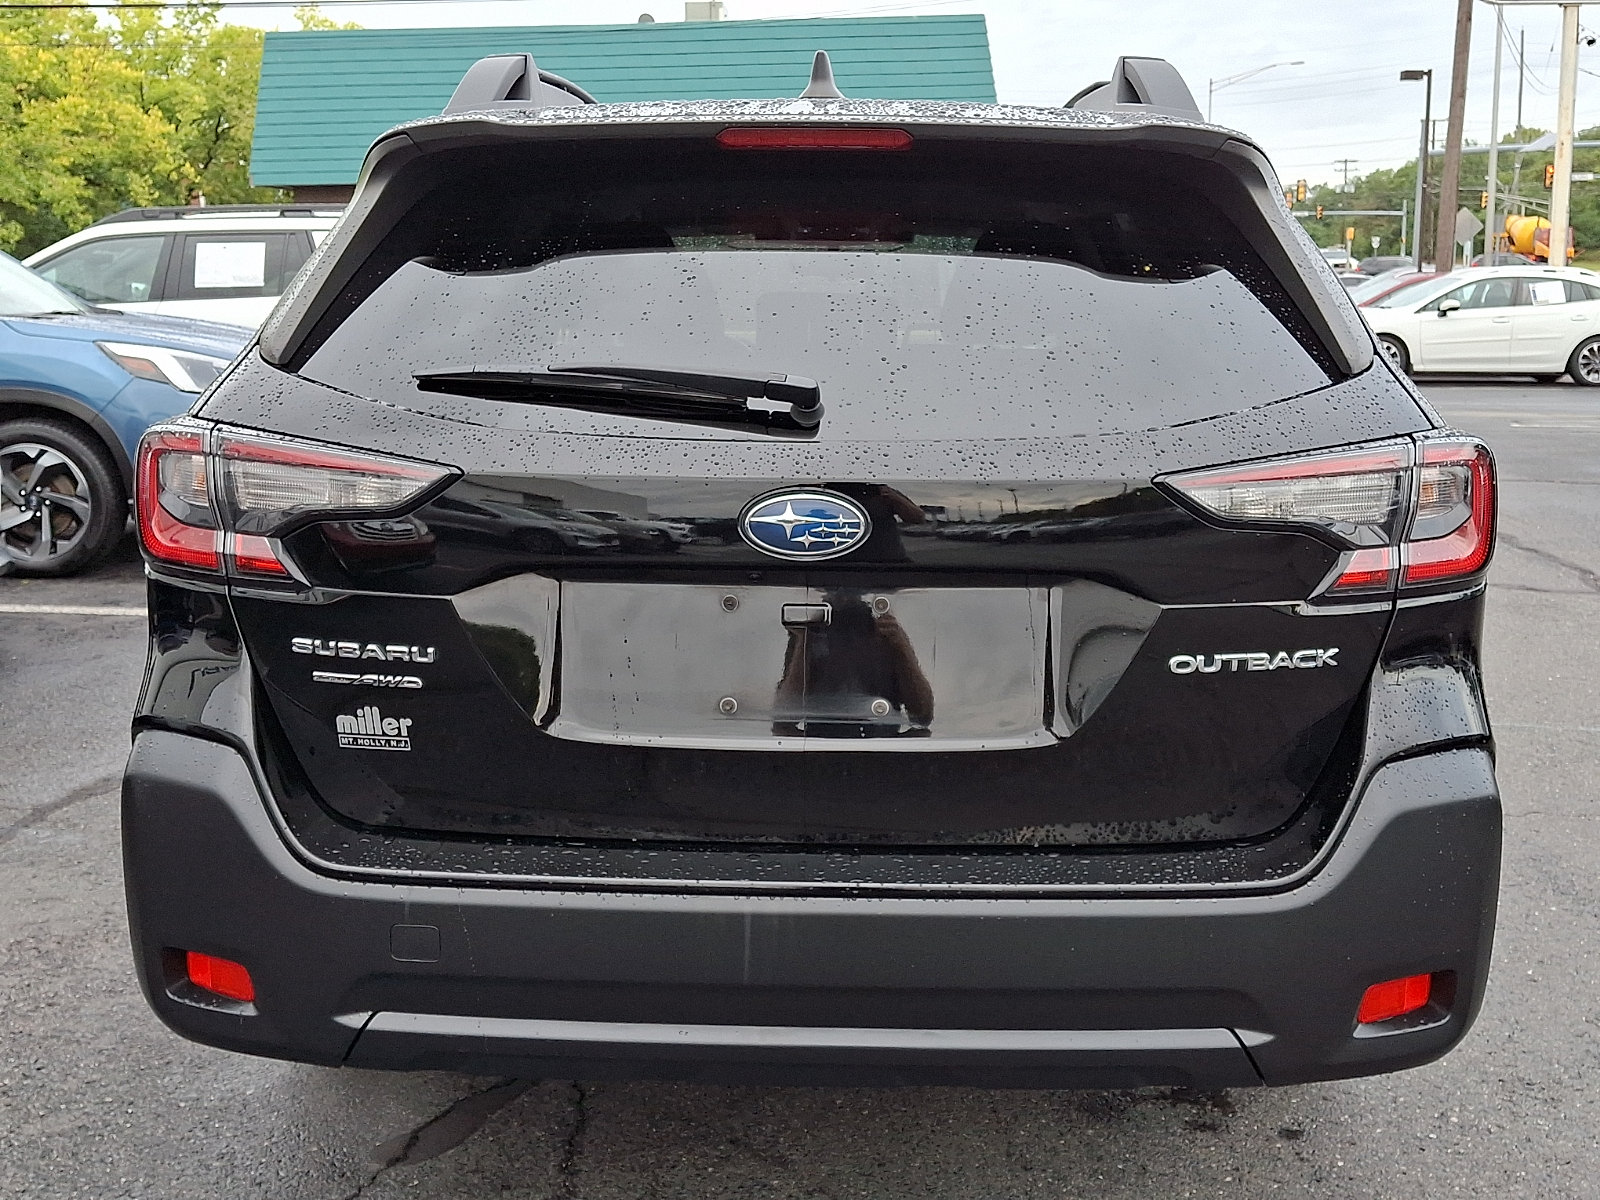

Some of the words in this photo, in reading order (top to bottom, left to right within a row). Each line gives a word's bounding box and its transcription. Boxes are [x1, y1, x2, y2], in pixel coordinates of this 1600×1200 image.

[291, 637, 436, 663] SUBARU
[1168, 647, 1340, 674] OUTBACK
[352, 674, 423, 689] AWD
[336, 706, 413, 736] miller
[341, 737, 356, 745] MT.
